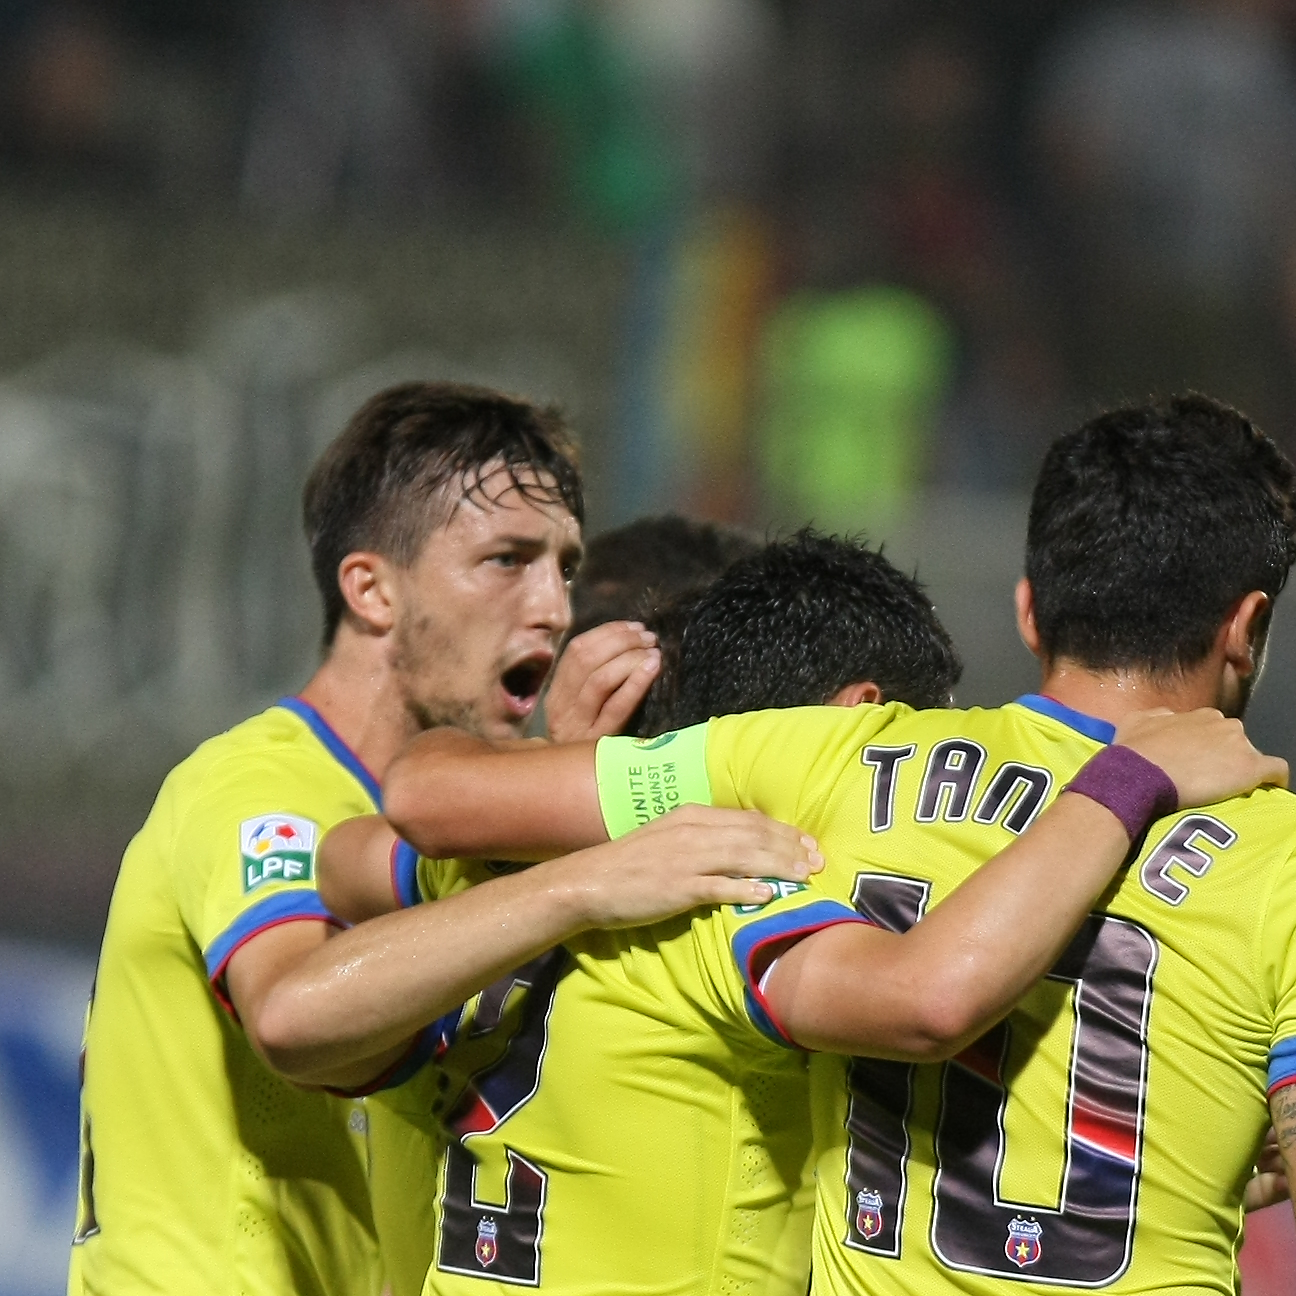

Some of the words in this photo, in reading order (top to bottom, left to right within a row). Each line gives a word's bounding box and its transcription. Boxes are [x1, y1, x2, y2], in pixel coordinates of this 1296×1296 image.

[629, 766, 650, 825] UNITE
[648, 765, 665, 814] GAINST
[862, 736, 1238, 906] TANE
[247, 856, 303, 886] LPF
[843, 870, 1160, 1290] 10
